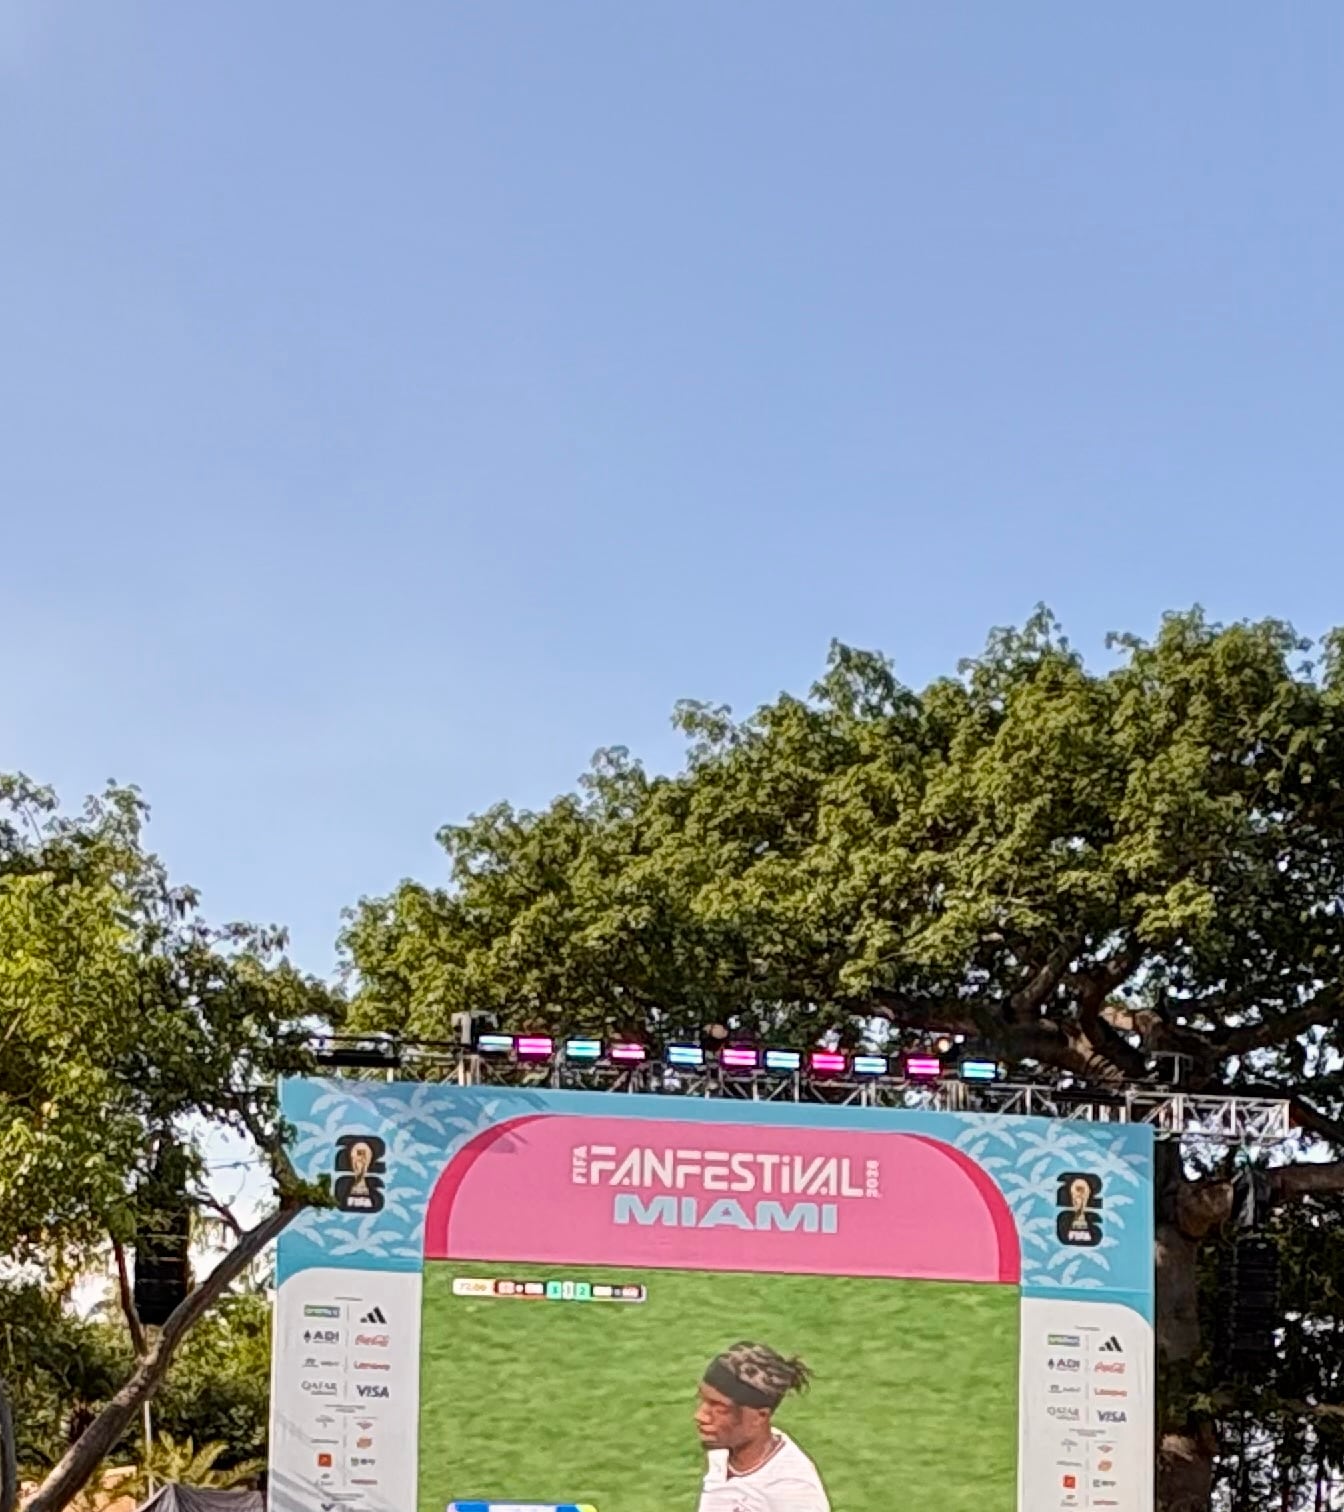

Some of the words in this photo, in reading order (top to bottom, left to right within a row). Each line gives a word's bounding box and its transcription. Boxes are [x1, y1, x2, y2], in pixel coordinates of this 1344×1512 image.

[571, 1146, 588, 1184] FIFA
[613, 1193, 838, 1234] MIAMI
[356, 1384, 390, 1398] VISA
[1096, 1410, 1128, 1423] VISA
